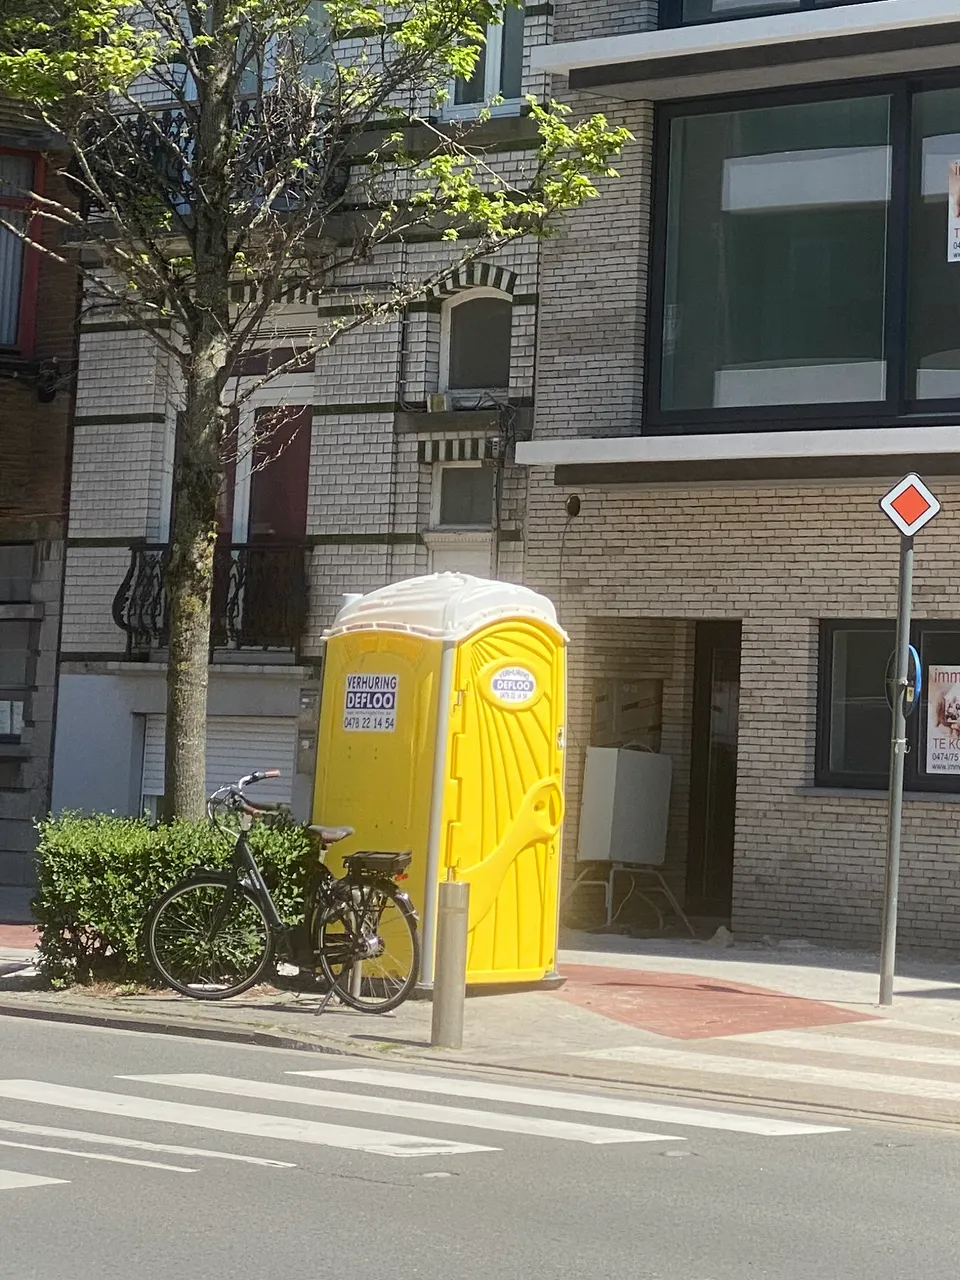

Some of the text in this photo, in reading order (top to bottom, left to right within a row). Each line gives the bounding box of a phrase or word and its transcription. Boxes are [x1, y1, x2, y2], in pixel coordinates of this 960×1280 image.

[347, 676, 397, 690] VERHURING
[497, 681, 530, 690] DEFLOO
[347, 693, 393, 708] DEFLOO
[344, 716, 394, 729] 0478 22 14 54
[933, 738, 946, 749] TE
[932, 753, 958, 761] 0474/75
